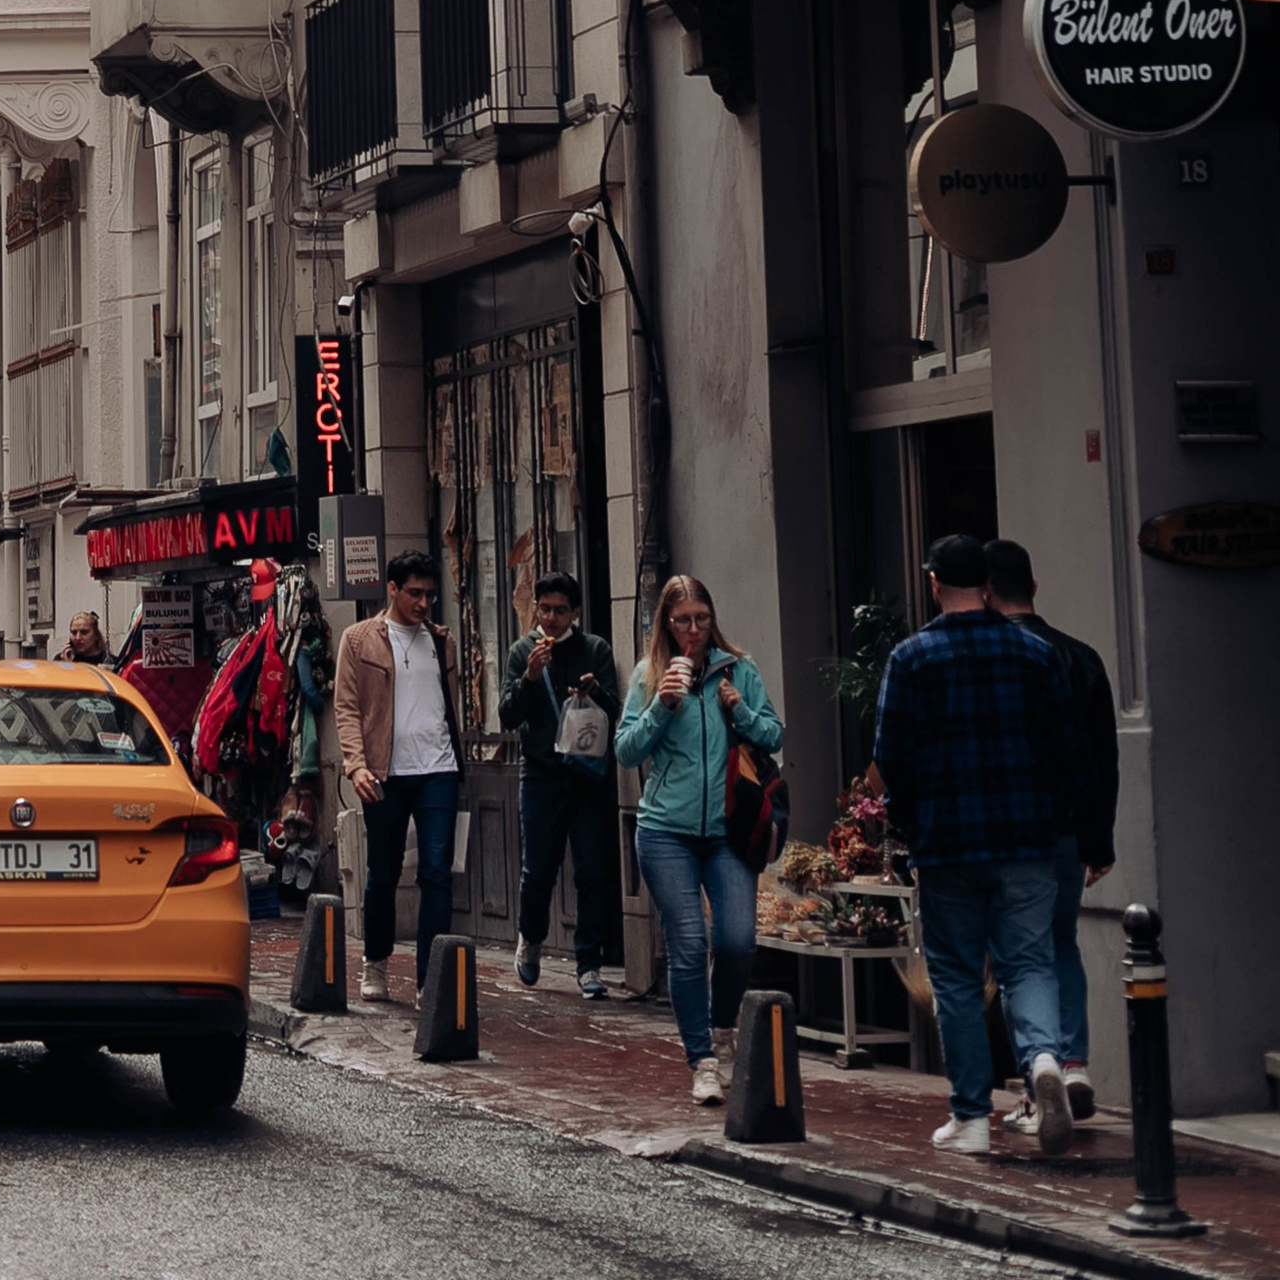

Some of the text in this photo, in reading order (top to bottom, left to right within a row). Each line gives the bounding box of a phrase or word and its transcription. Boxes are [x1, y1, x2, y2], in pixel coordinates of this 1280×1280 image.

[1085, 64, 1212, 85] HAIR STUDIO
[1181, 160, 1208, 182] 18
[214, 507, 293, 549] AVM
[145, 609, 190, 618] BULUNUR
[0, 843, 42, 869] TDJ
[68, 843, 93, 869] 31
